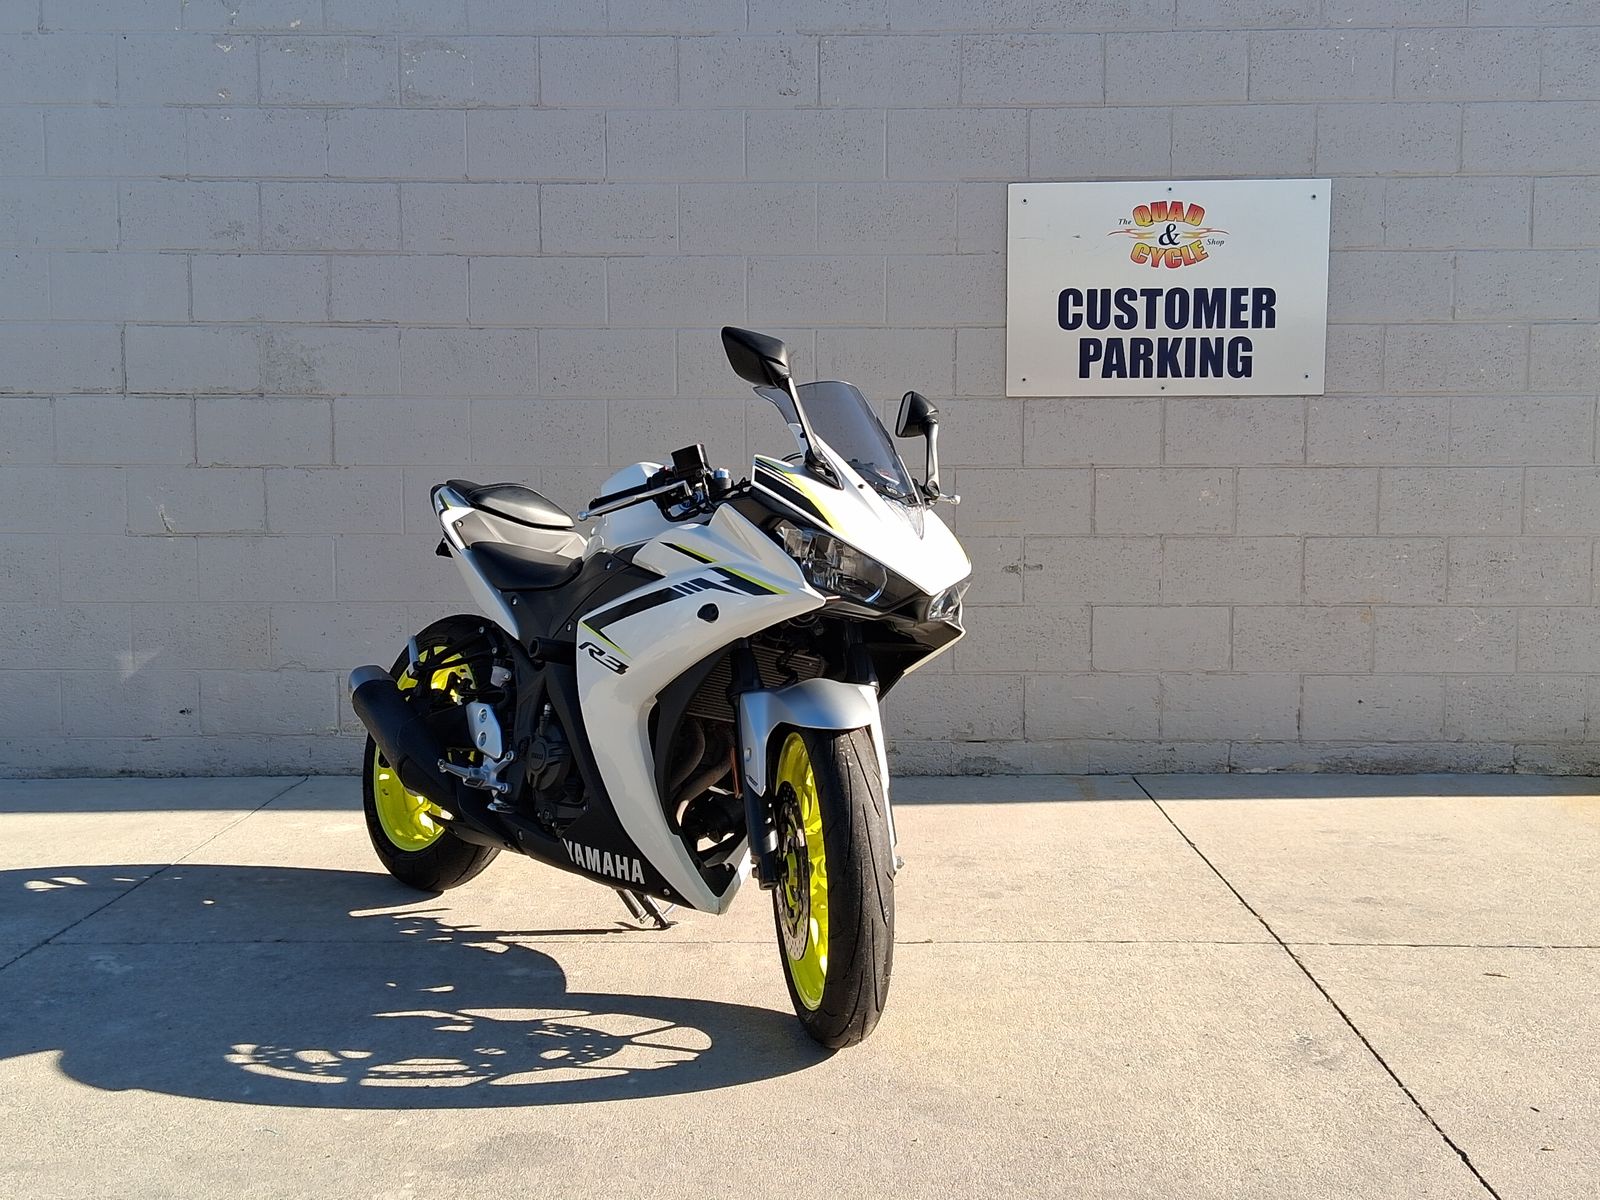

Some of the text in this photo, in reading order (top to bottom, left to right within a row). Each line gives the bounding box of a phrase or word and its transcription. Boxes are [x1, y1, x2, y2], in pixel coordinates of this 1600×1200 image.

[1132, 200, 1206, 227] QUAD
[1158, 223, 1180, 246] &
[1206, 238, 1225, 247] Shop
[1130, 240, 1209, 269] CYCLE
[1057, 287, 1277, 331] CUSTOMER
[1078, 336, 1253, 379] PARKING
[578, 641, 630, 675] R3
[562, 838, 646, 885] YAMAHA
